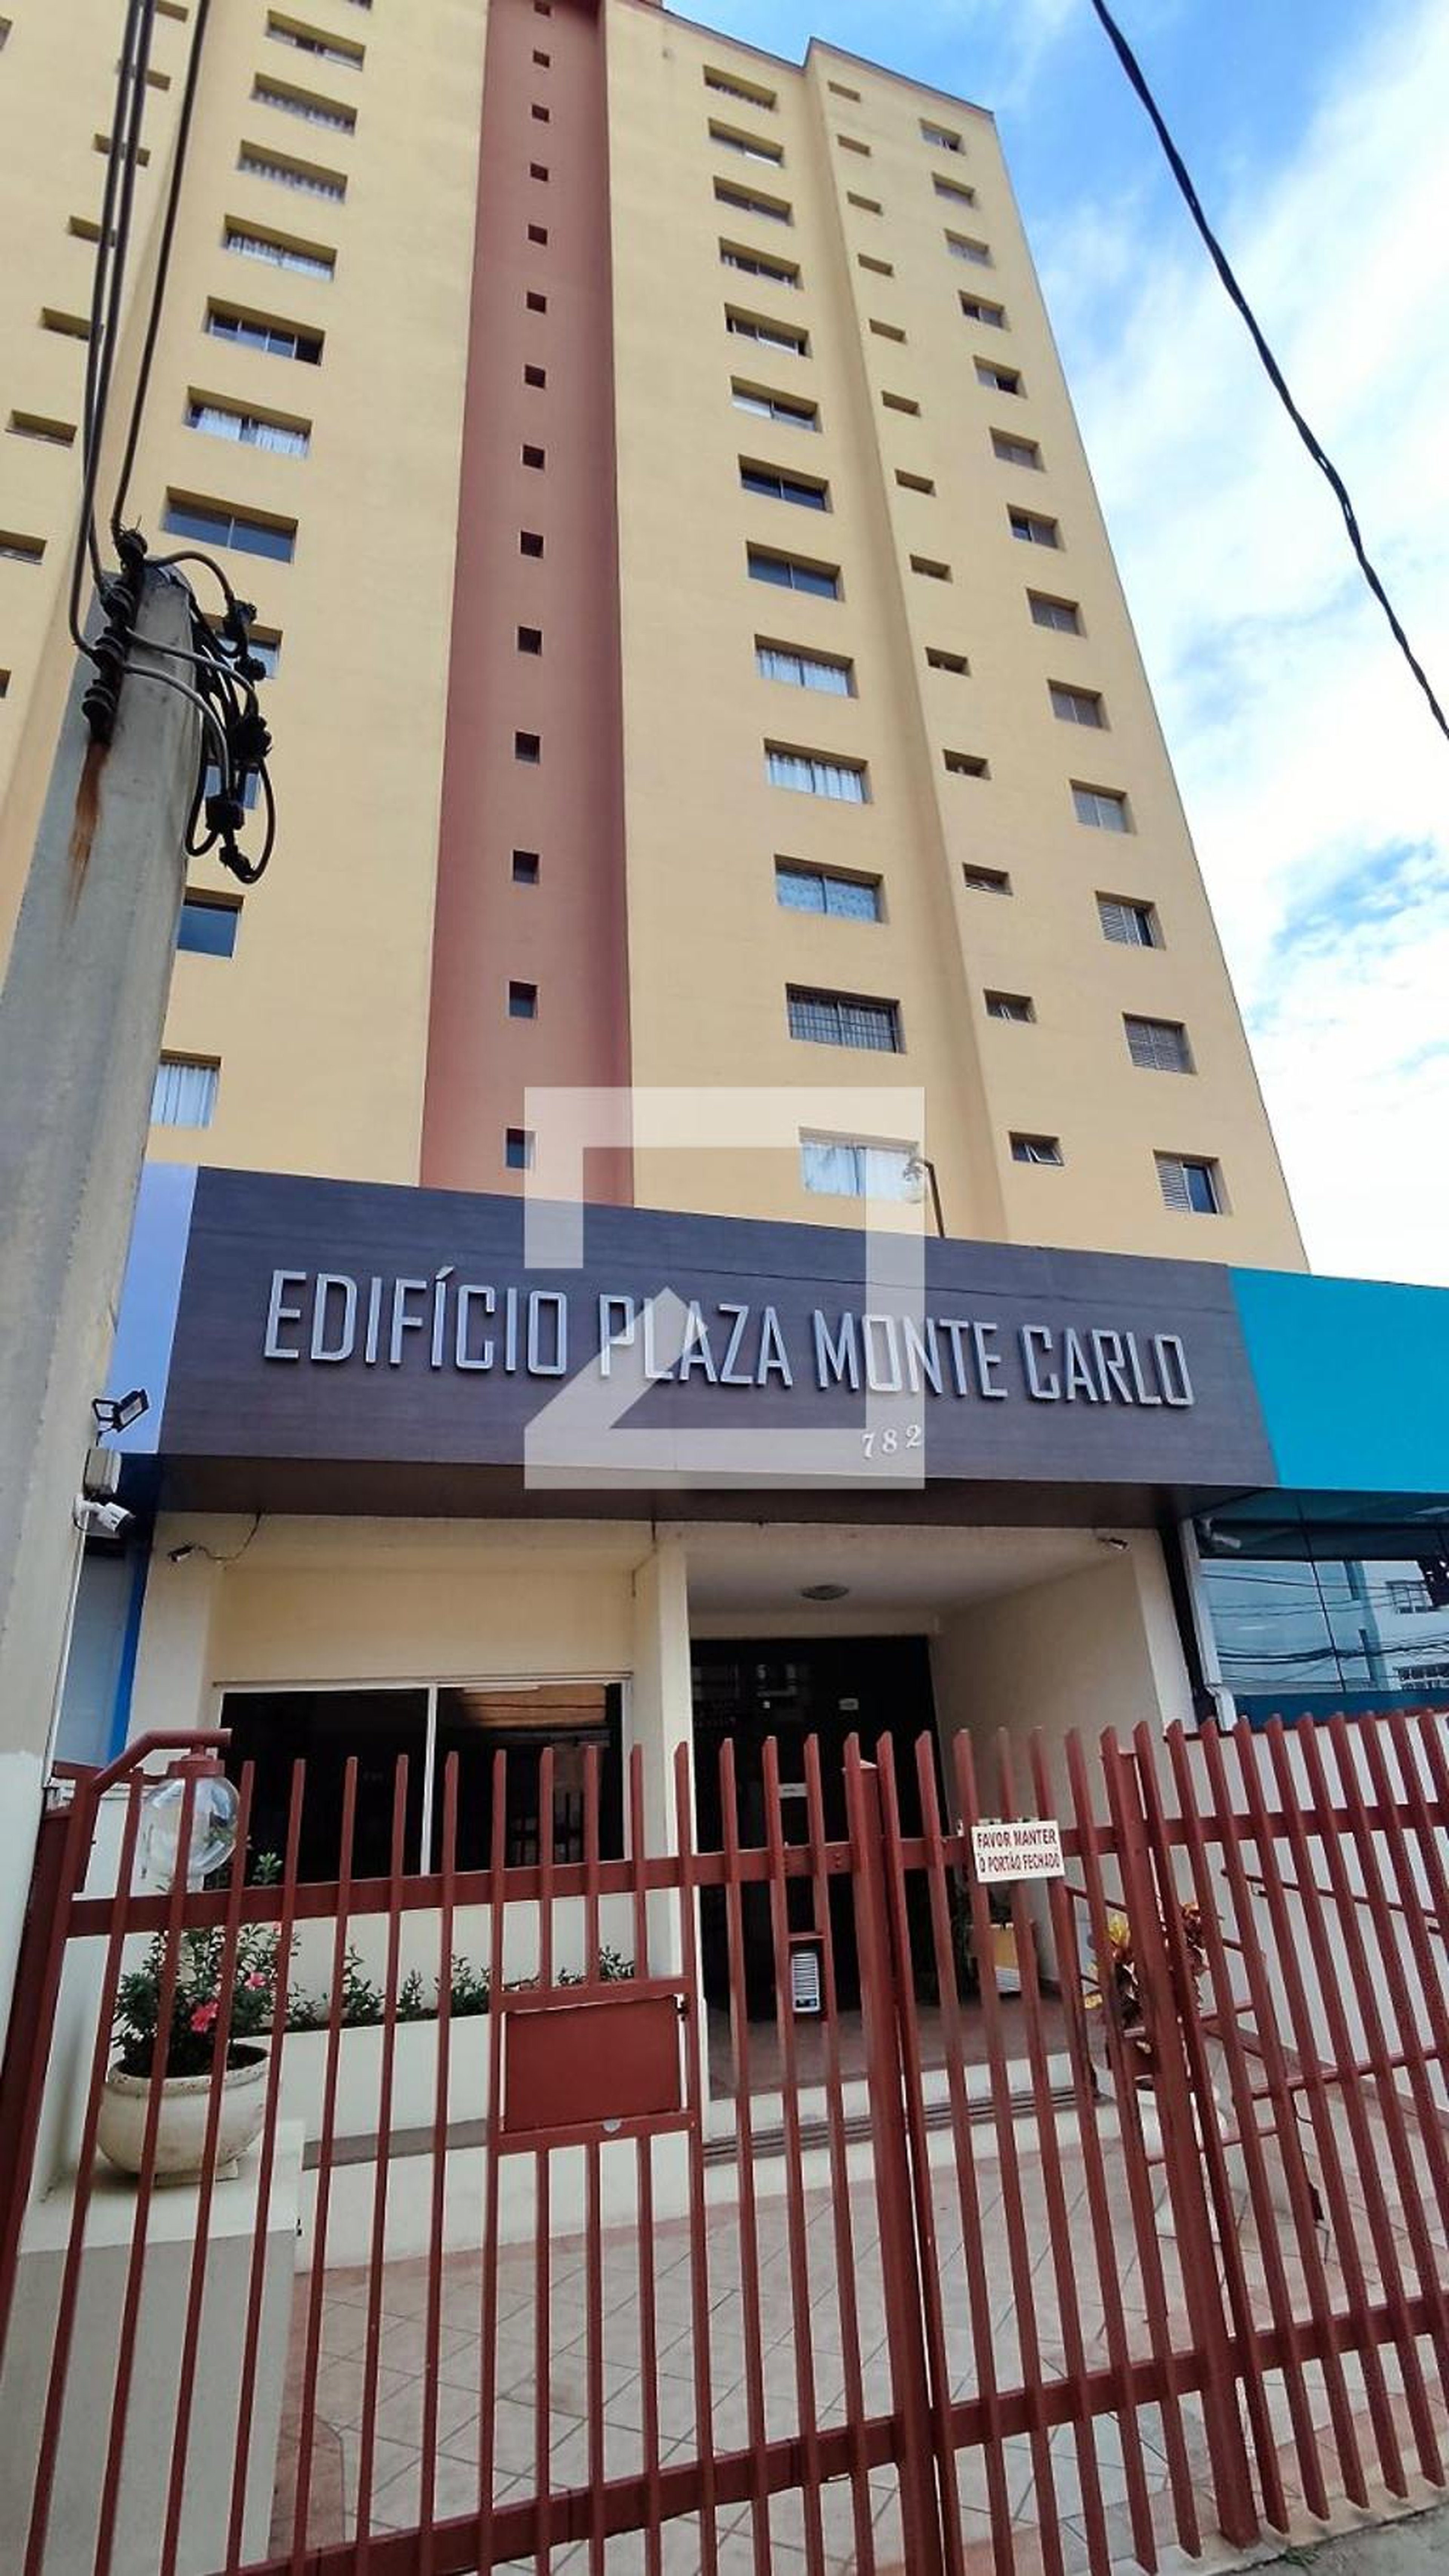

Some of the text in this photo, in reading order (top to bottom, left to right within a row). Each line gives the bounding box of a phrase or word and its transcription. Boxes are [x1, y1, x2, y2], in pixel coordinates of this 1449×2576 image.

[264, 1266, 1195, 1406] EDIFÍCIO PLAZA MONTE CARLO
[862, 1425, 922, 1458] 782
[977, 1828, 1057, 1848] FAVOR MANTER
